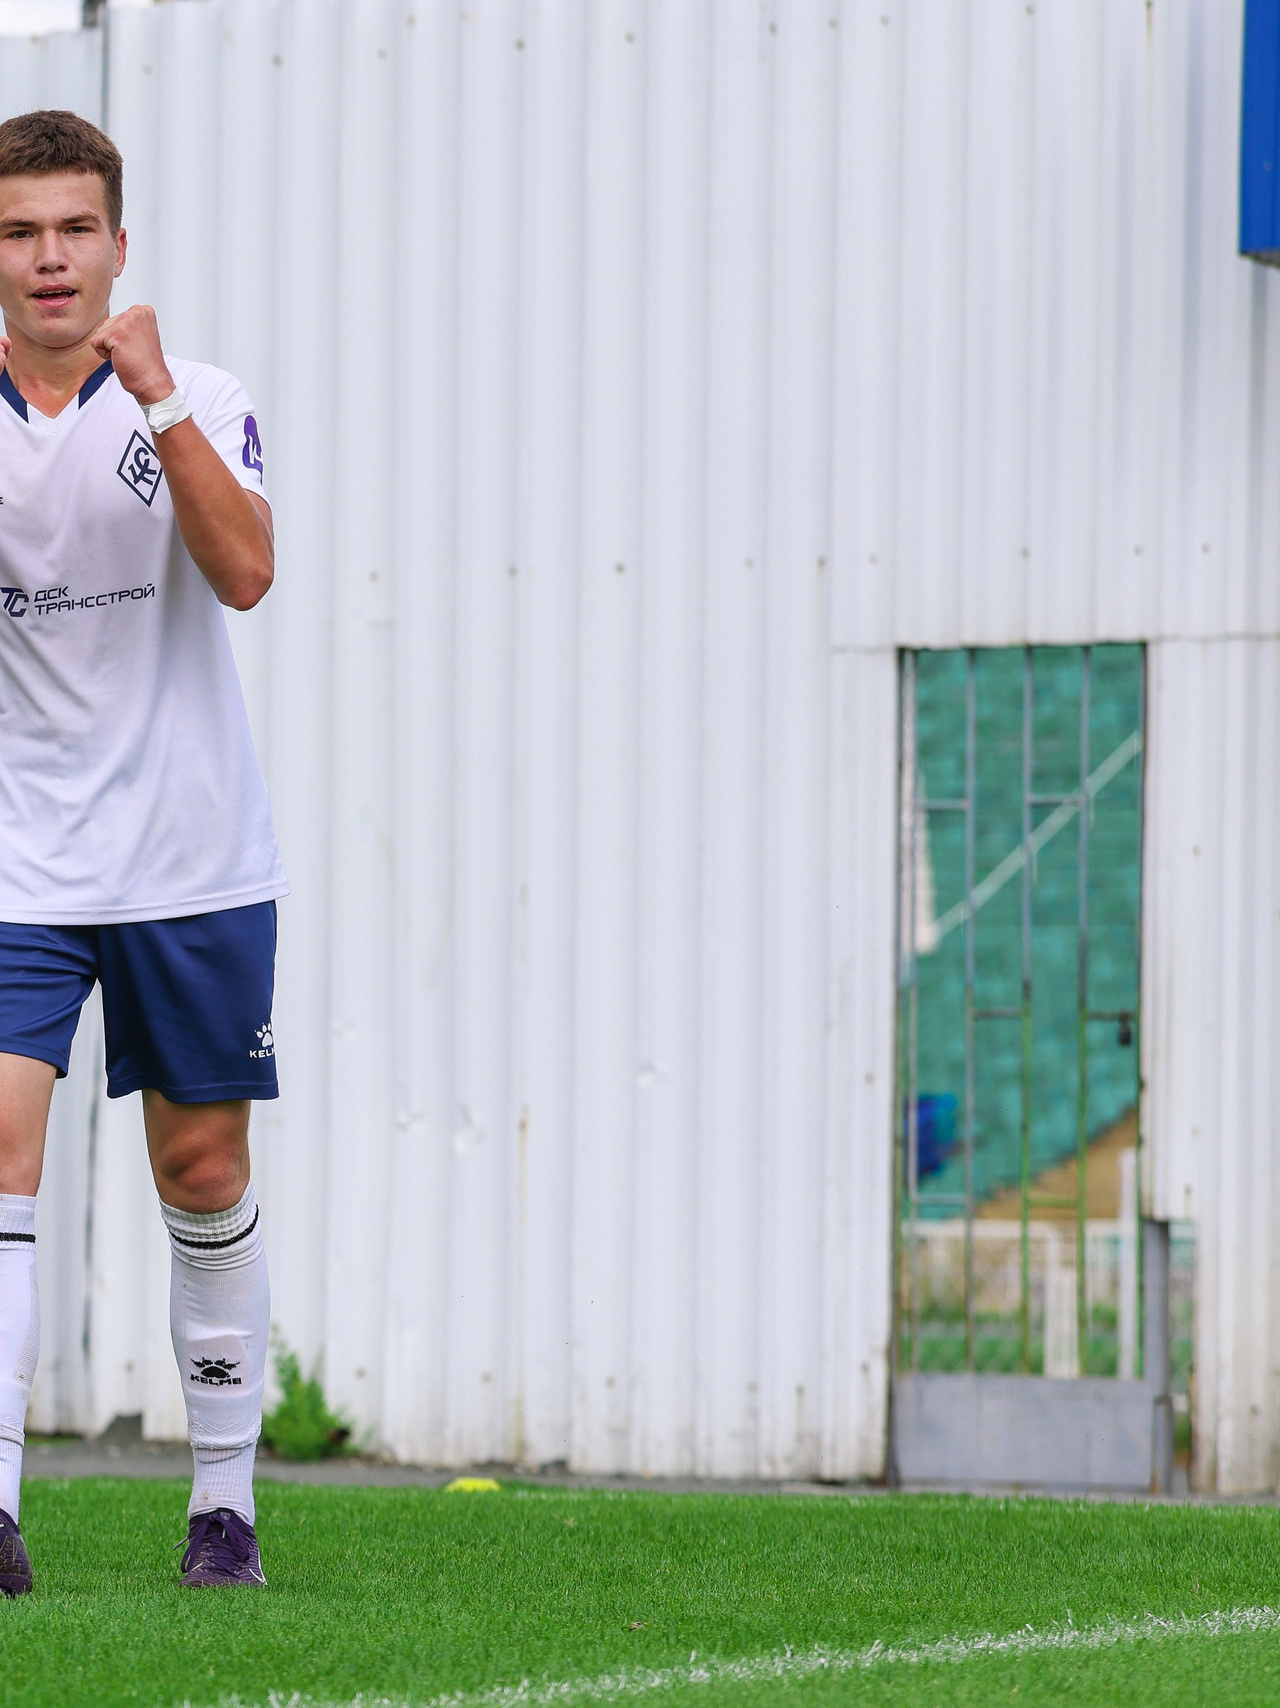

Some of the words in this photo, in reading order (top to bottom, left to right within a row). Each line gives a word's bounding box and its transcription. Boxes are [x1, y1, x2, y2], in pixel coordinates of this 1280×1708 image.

[33, 585, 69, 602] ДСК
[34, 583, 156, 616] ТРАНССТРОЙ
[249, 1047, 274, 1058] KEL
[190, 1373, 242, 1386] KELME
